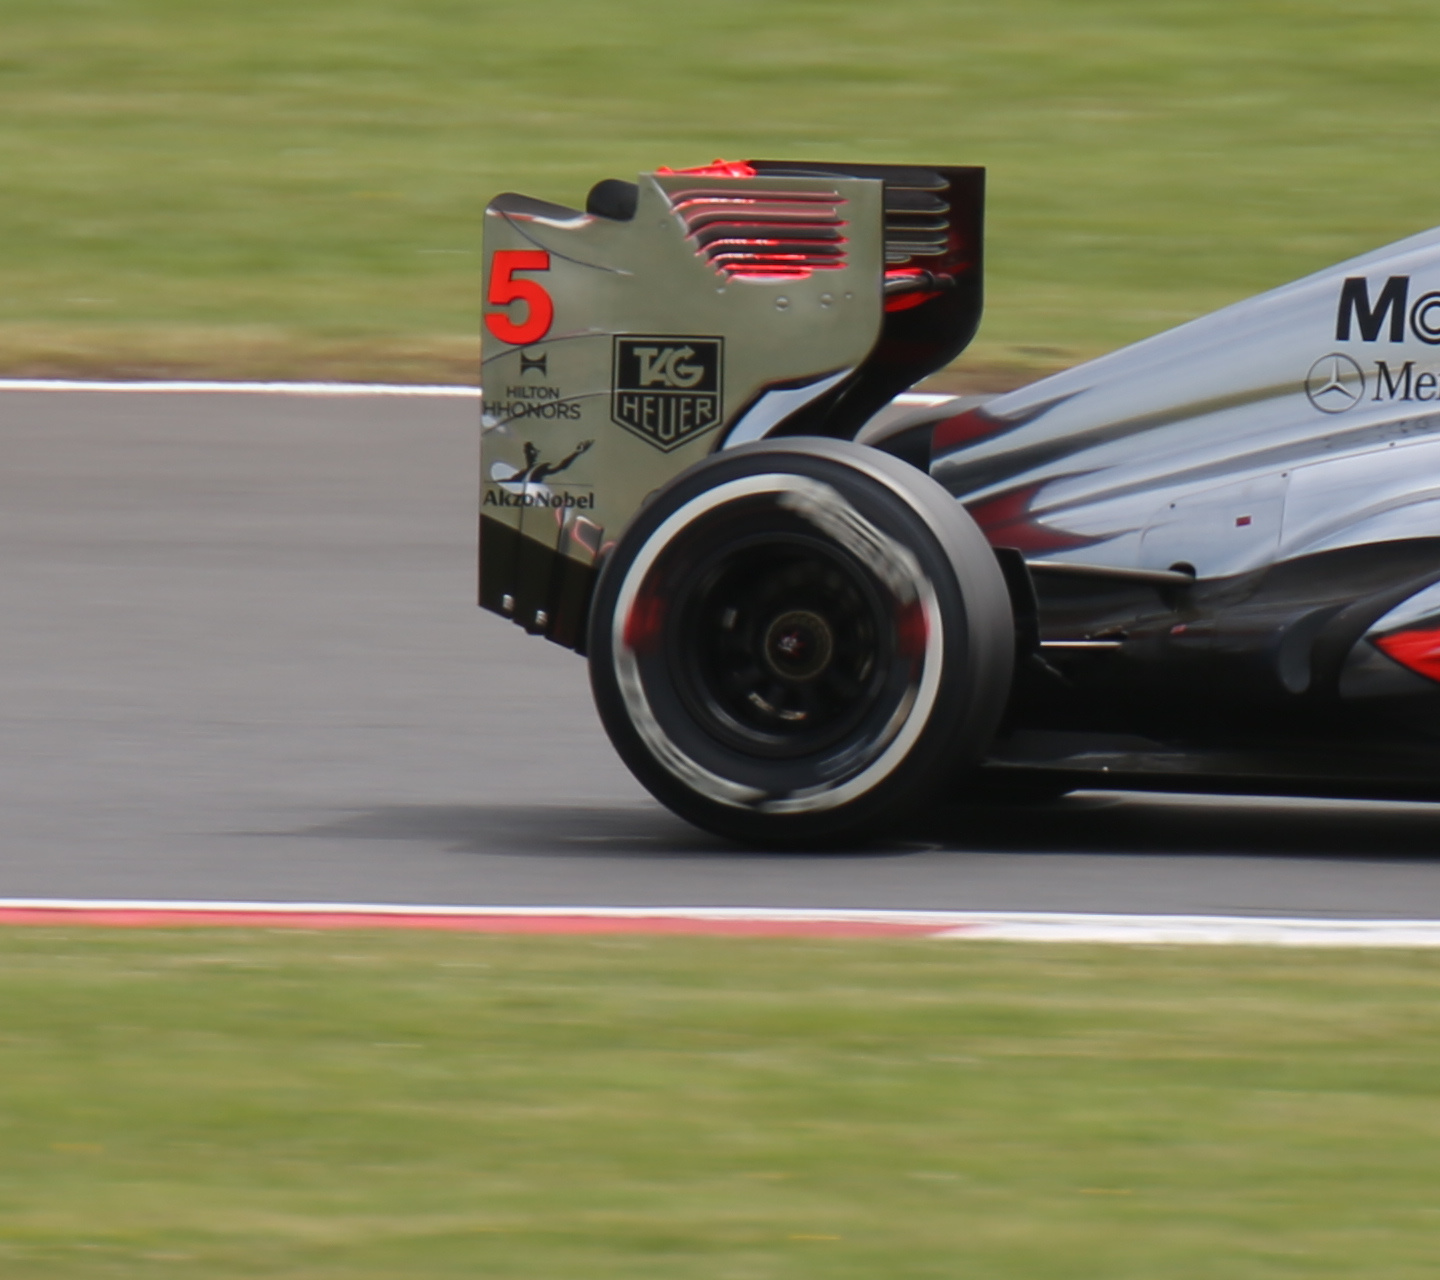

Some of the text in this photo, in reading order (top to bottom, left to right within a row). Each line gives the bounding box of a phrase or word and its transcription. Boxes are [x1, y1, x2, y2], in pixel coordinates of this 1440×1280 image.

[485, 250, 553, 345] 5
[633, 345, 704, 388] TAG
[507, 386, 559, 399] HILTON
[483, 401, 581, 420] HHONORS
[623, 396, 712, 440] HEUER
[484, 489, 594, 509] AkzoNobel
